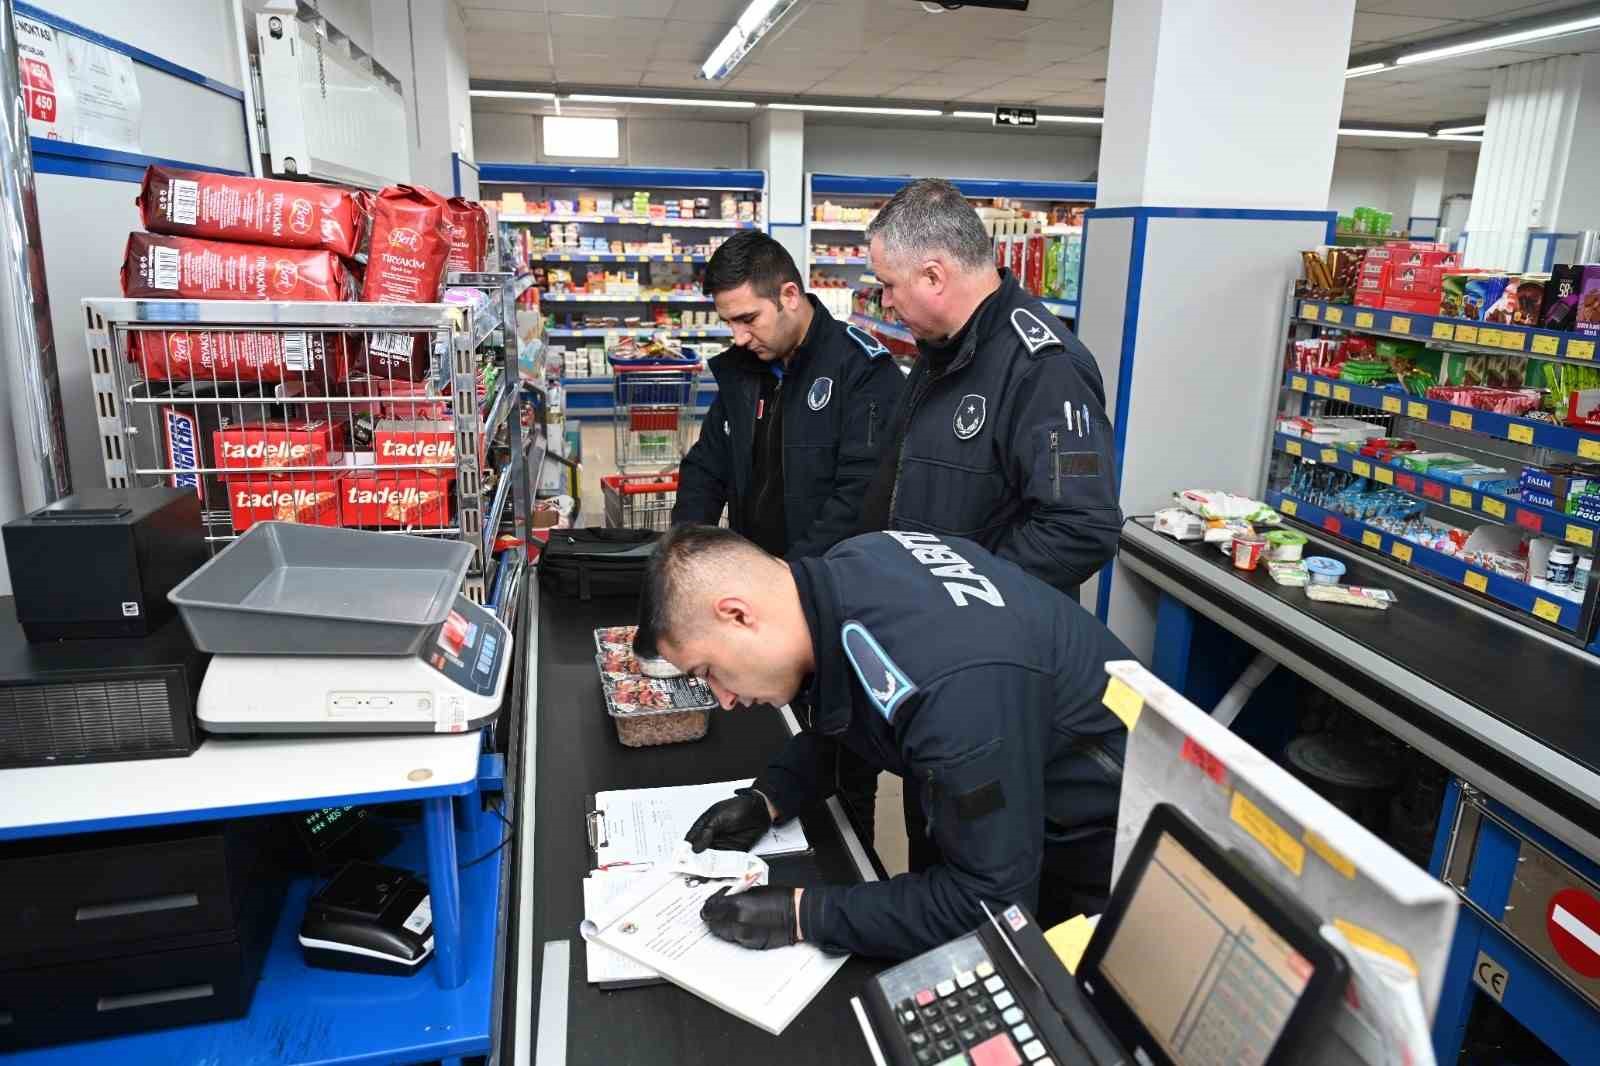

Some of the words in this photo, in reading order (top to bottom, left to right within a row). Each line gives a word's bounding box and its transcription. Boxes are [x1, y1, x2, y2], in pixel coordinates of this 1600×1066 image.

[35, 96, 52, 111] 450
[222, 441, 305, 458] tadelle
[236, 490, 320, 508] tadelle
[348, 487, 430, 504] tadelle
